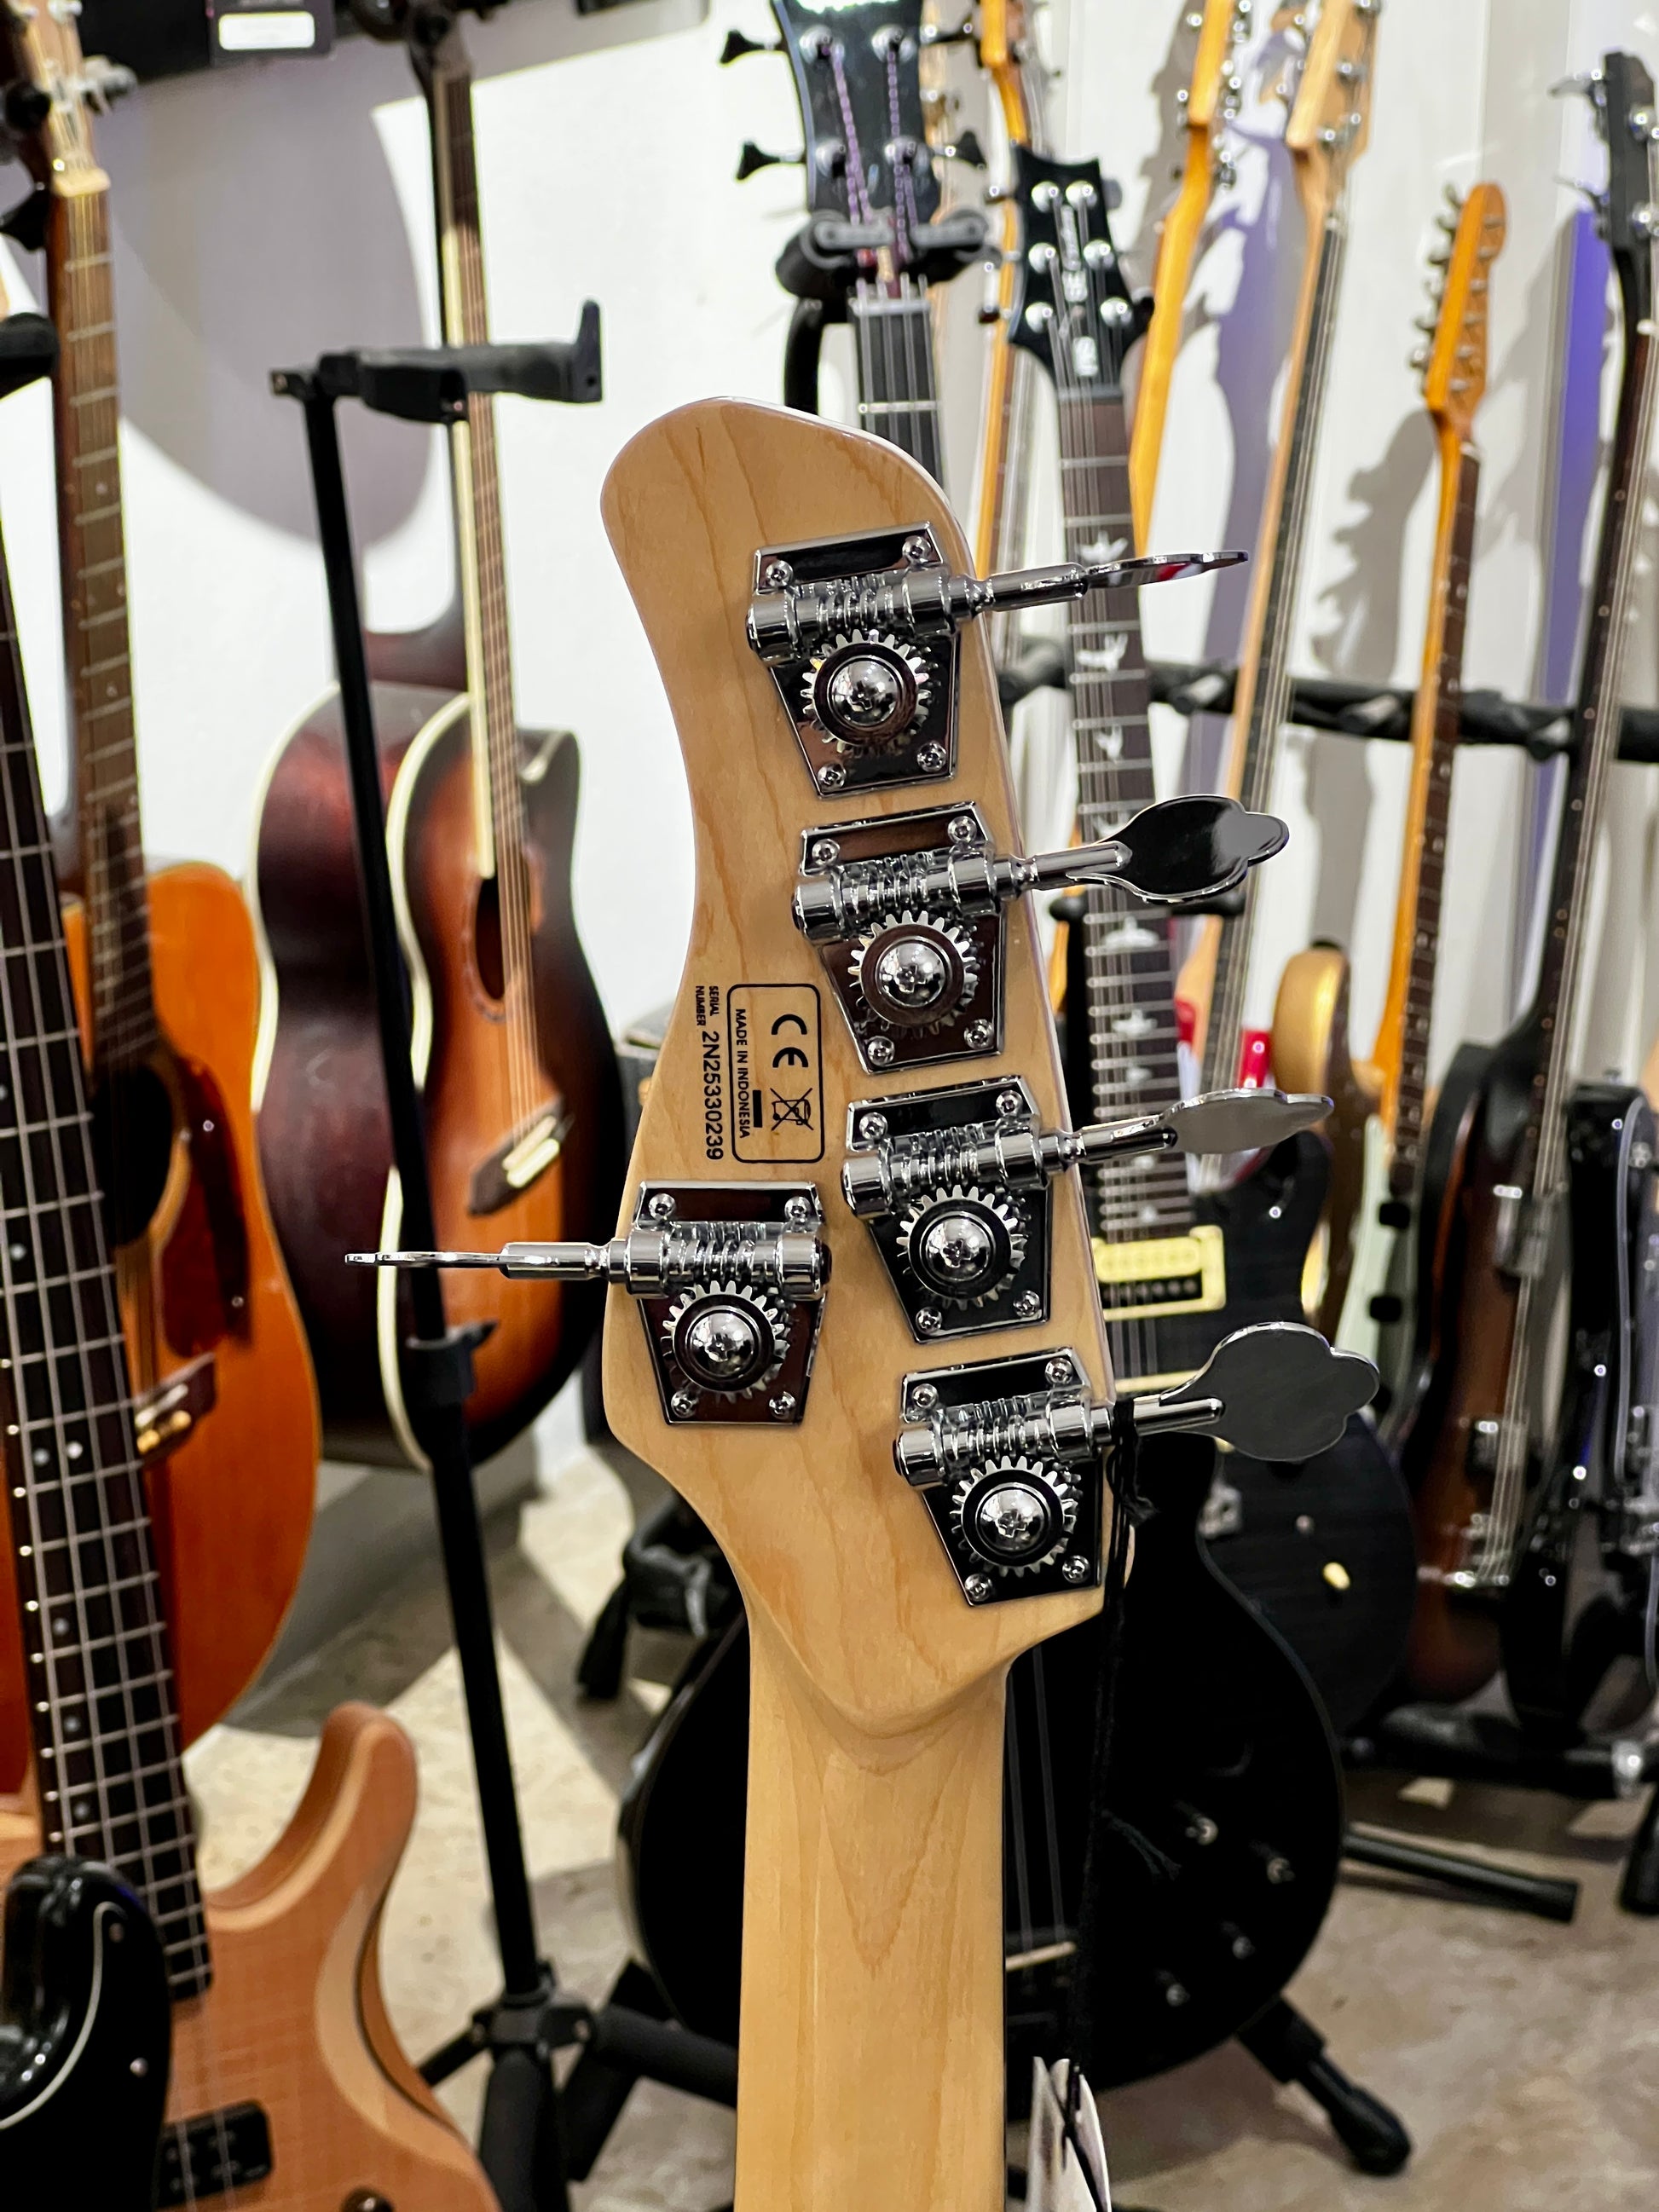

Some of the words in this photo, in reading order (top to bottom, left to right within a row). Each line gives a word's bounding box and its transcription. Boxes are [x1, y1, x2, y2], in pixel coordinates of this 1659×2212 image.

[695, 985, 707, 1026] NUMBER
[708, 985, 720, 1017] SERIAL
[735, 1008, 748, 1046] MADE
[771, 1014, 809, 1069] CE
[737, 1050, 749, 1064] IN
[702, 1031, 725, 1160] 2N25330239
[737, 1067, 751, 1139] INDONESIA
